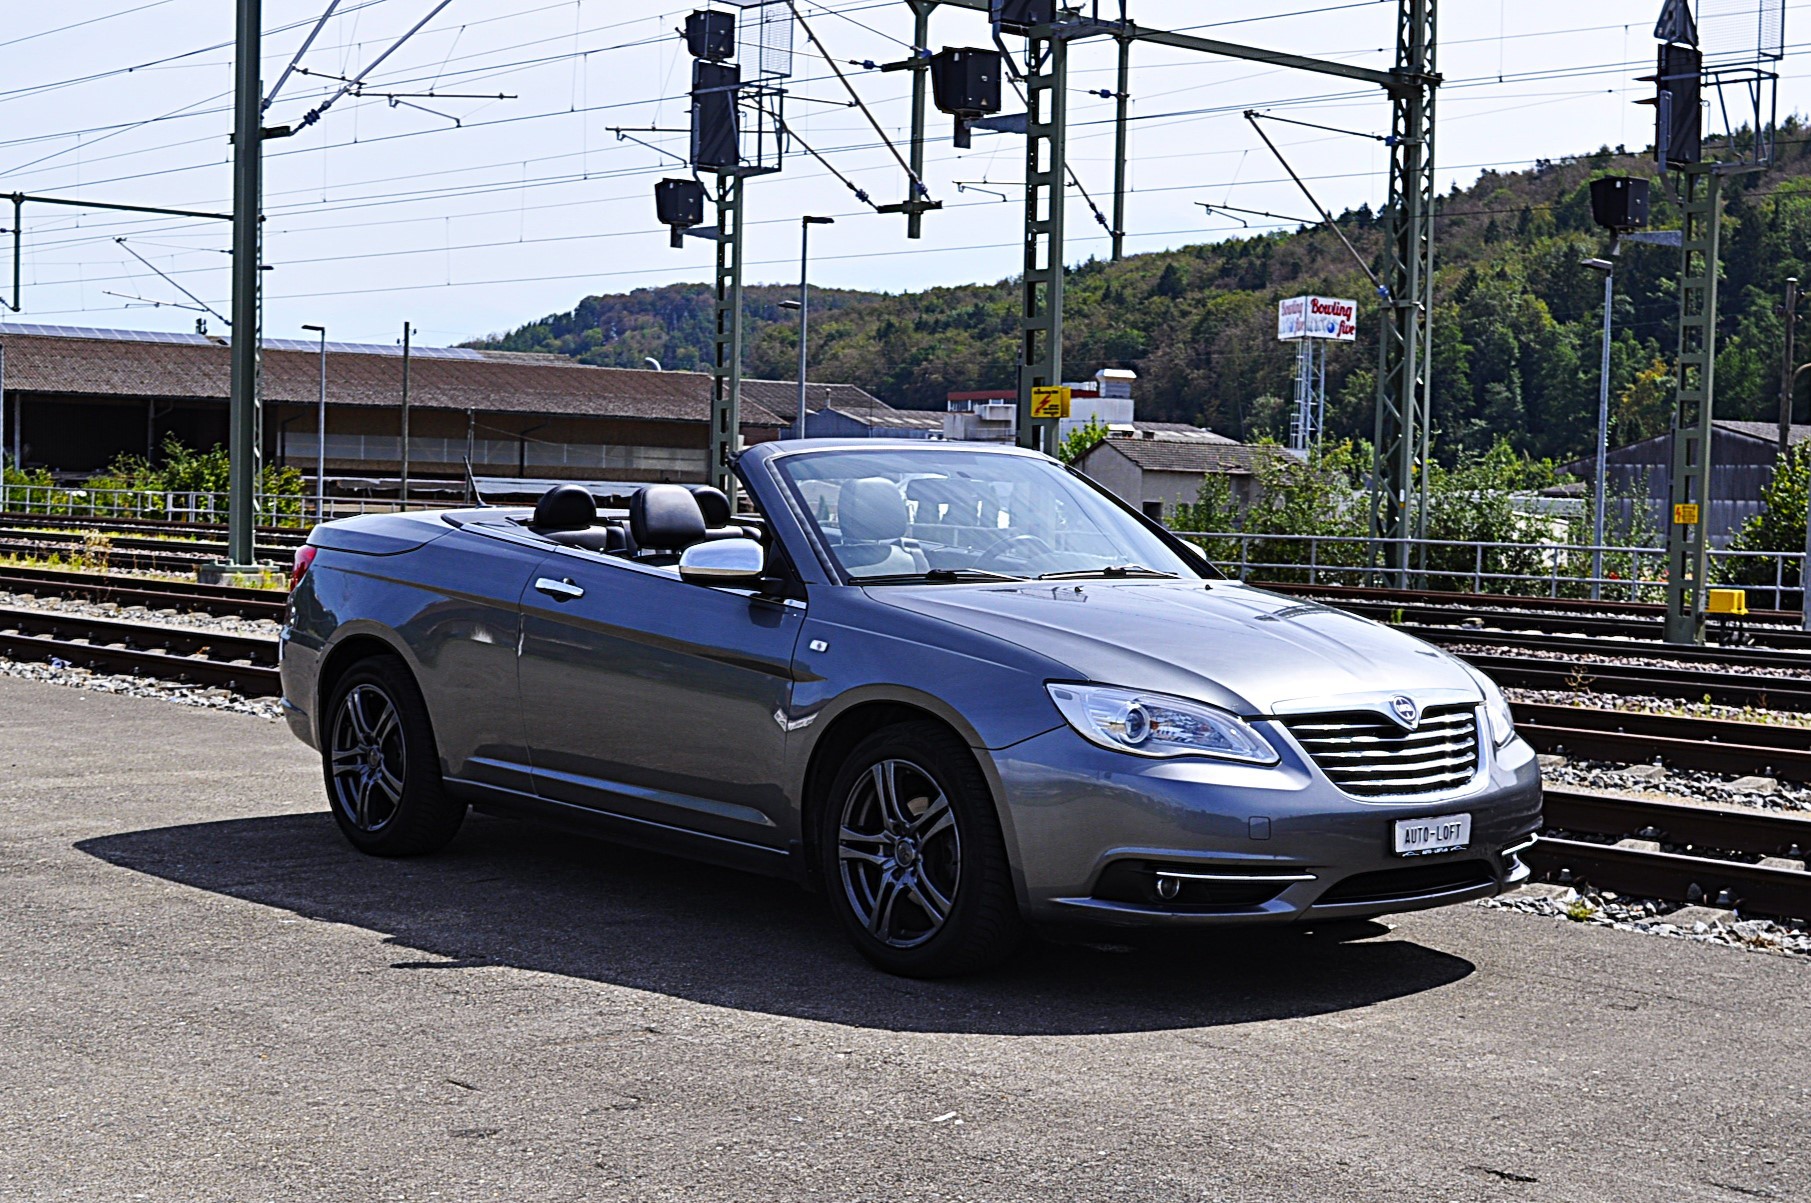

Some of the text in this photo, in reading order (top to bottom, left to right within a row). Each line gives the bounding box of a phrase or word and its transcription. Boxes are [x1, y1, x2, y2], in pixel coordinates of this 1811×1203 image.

[1310, 297, 1352, 321] Bowling
[1337, 319, 1355, 337] five
[1404, 822, 1462, 844] AUTO-LOFT
